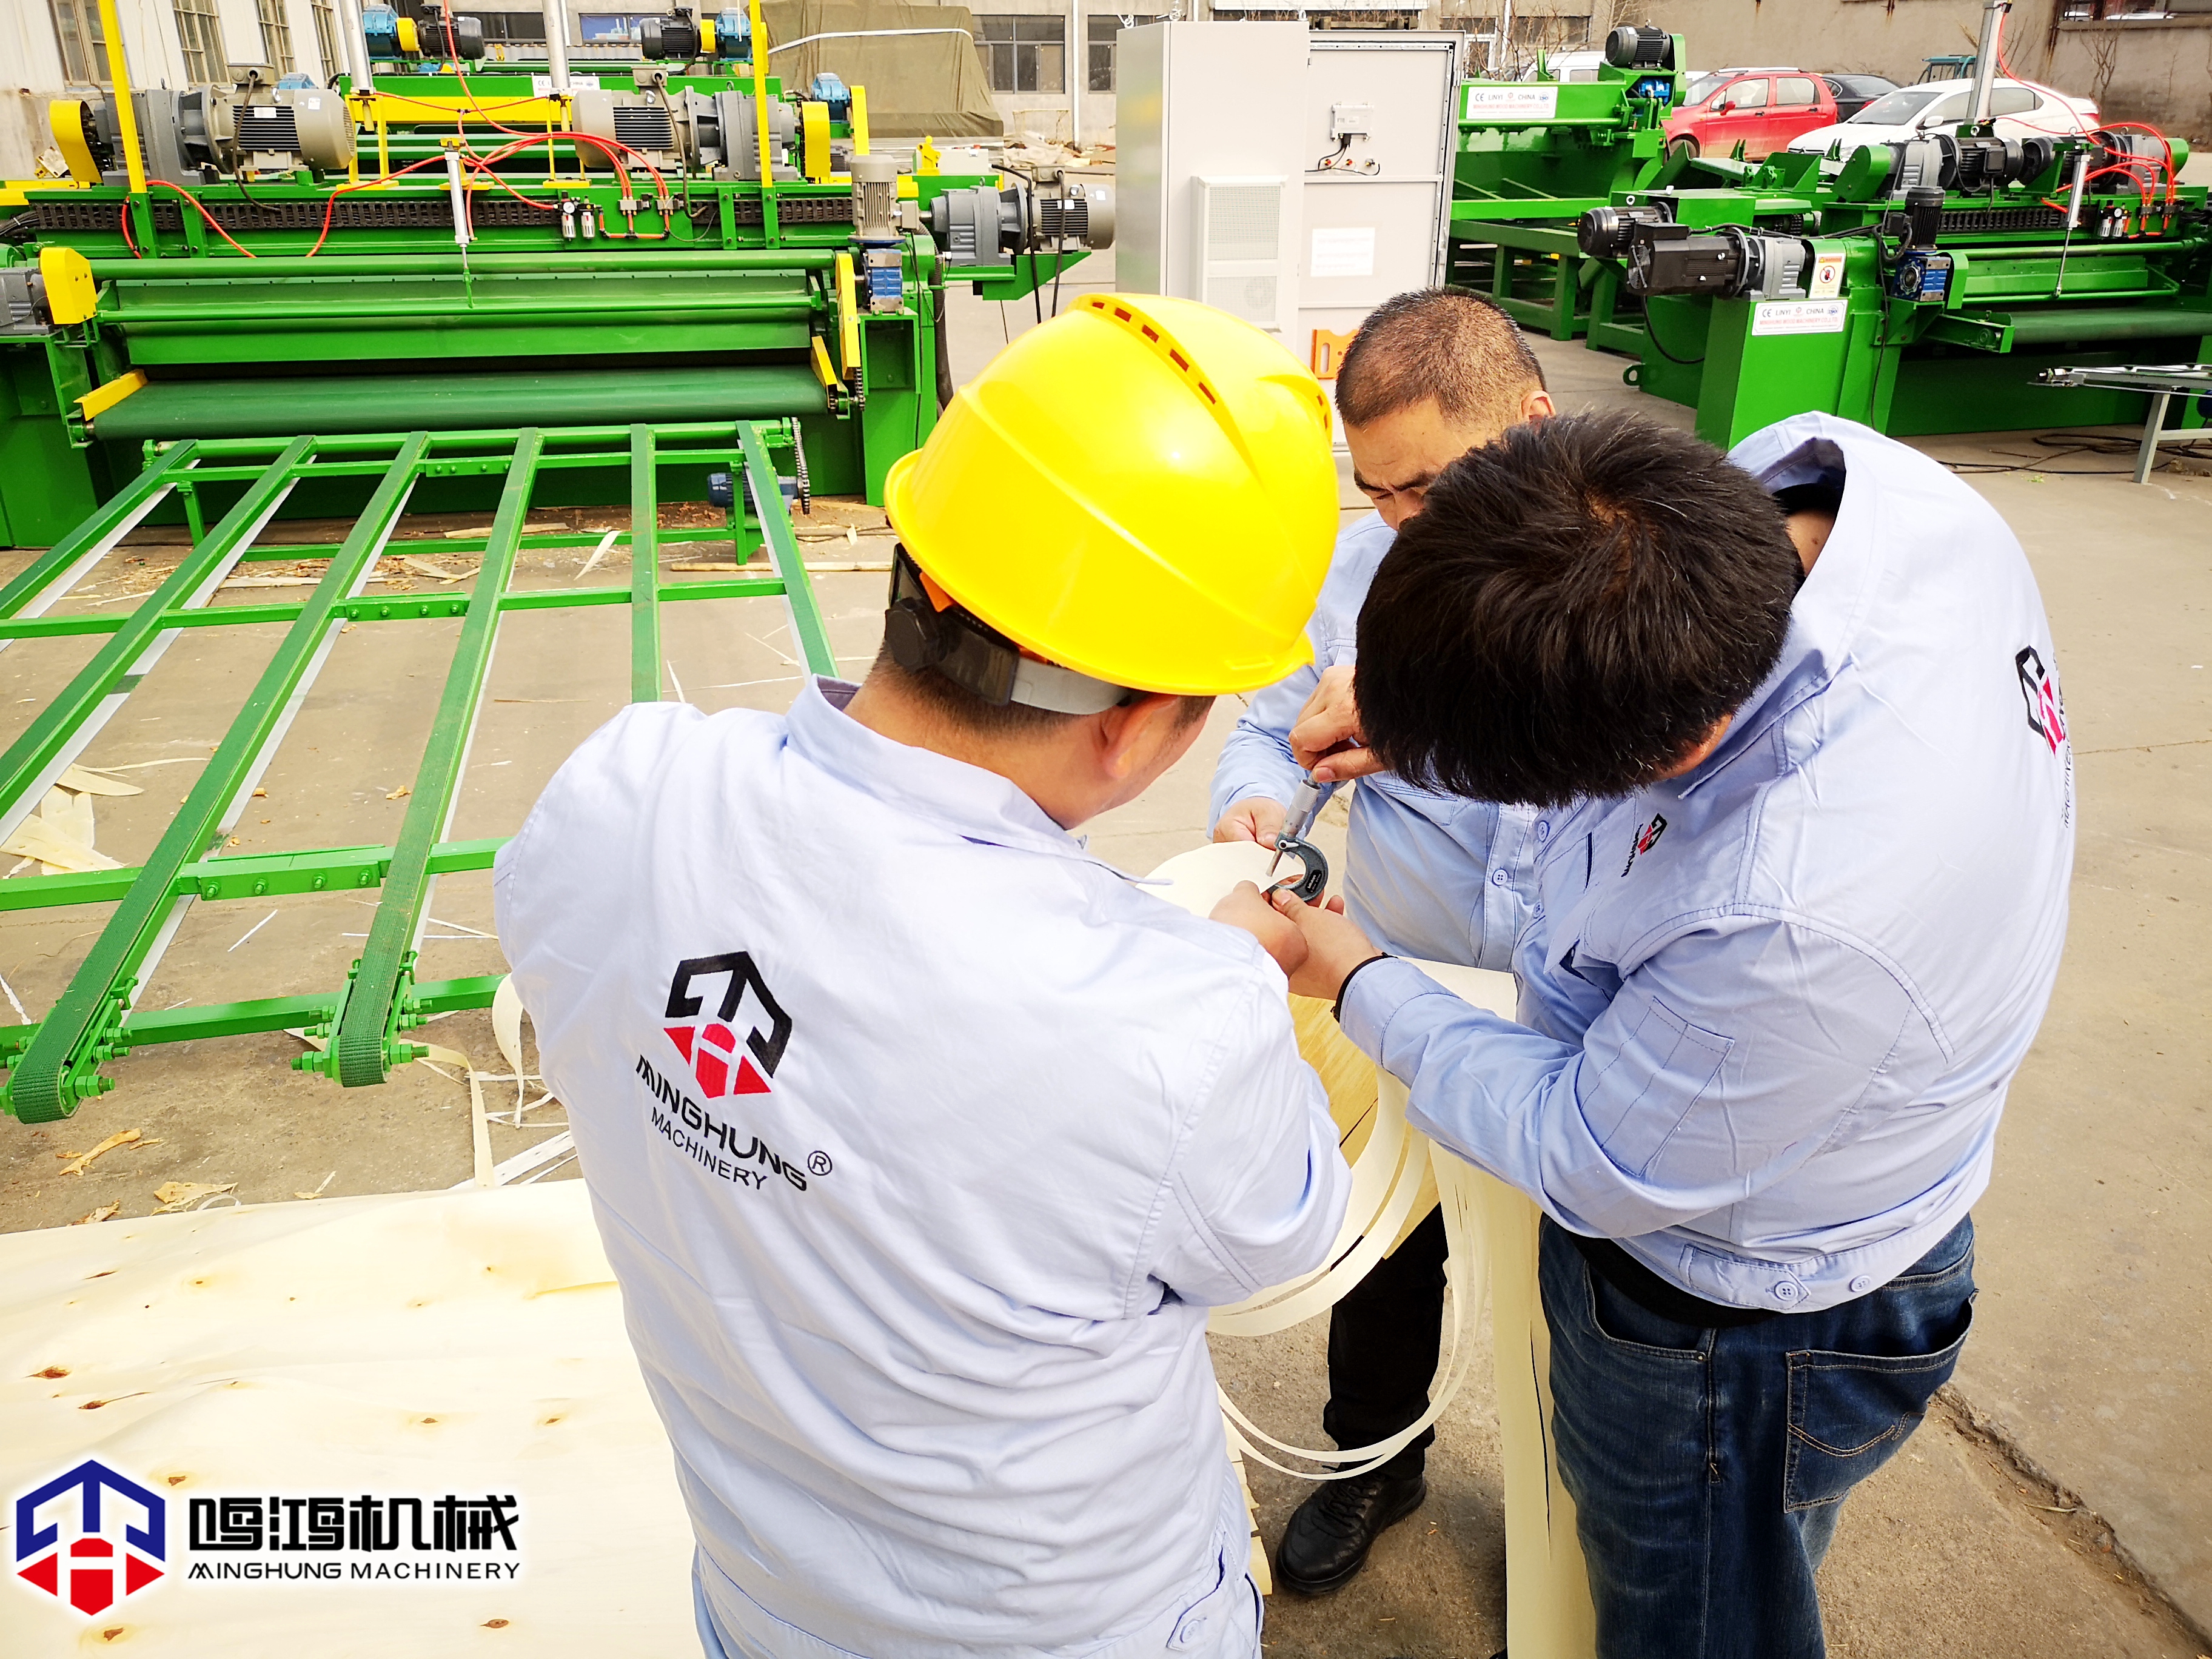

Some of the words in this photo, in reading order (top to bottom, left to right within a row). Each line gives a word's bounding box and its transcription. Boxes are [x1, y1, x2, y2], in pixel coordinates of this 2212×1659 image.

[1475, 93, 1484, 101] CE
[1762, 309, 1772, 317] CE
[635, 1054, 807, 1191] MINGHUNG
[652, 1106, 768, 1190] MACHINERY
